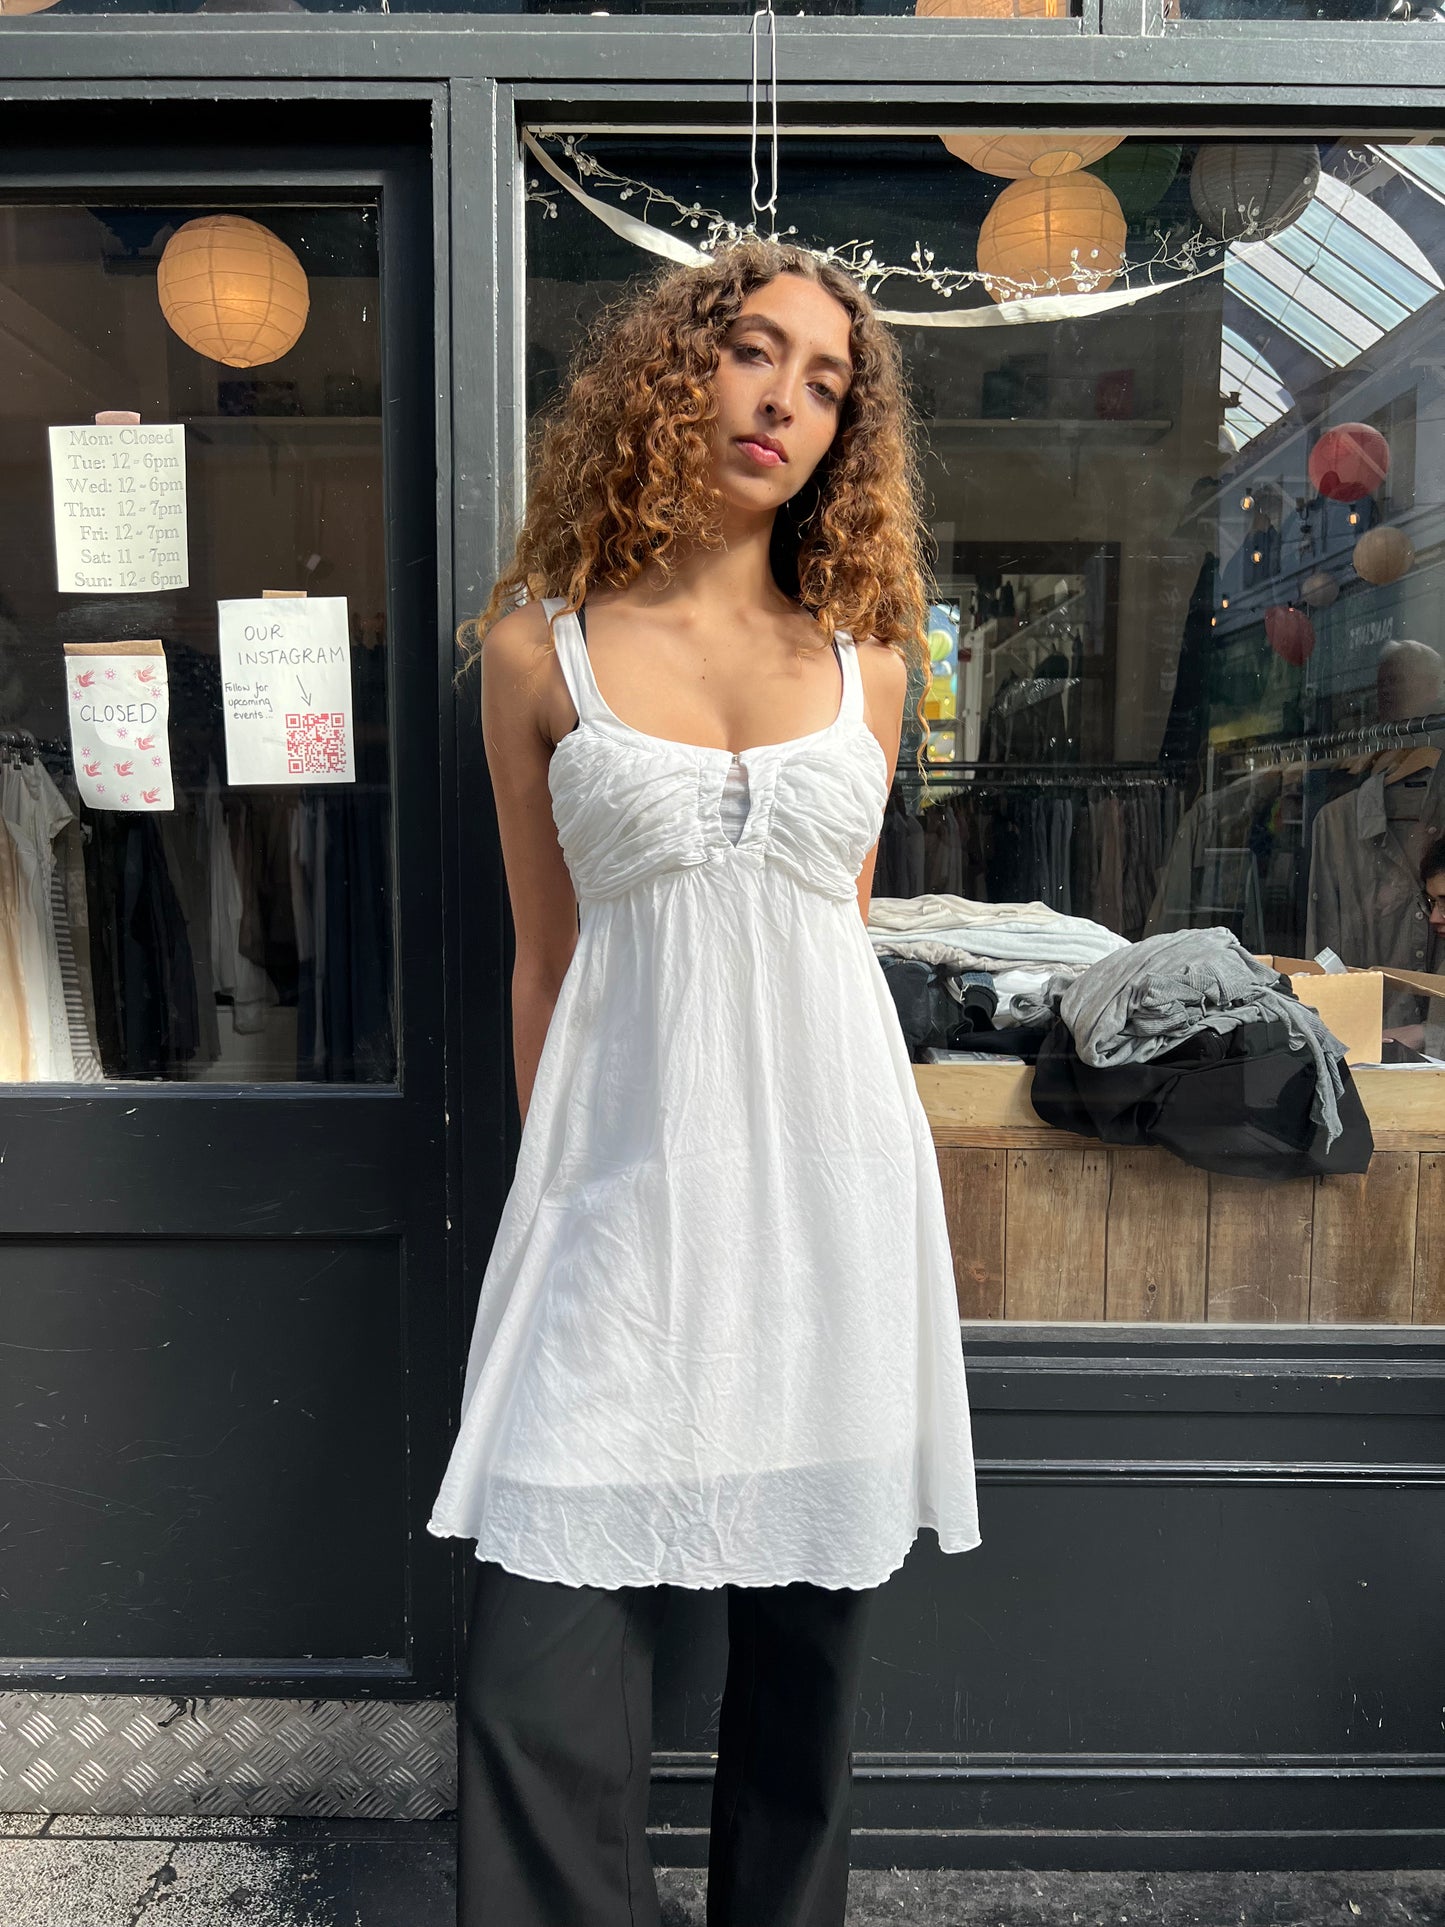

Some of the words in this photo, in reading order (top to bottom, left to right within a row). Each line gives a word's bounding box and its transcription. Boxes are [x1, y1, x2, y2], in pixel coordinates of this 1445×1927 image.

[69, 430, 113, 446] Mon:
[119, 428, 175, 445] Closed
[67, 454, 106, 469] Tue:
[65, 478, 112, 493] Wed:
[63, 502, 106, 517] Thu:
[79, 525, 109, 540] Fri:
[80, 549, 112, 564] Sat:
[74, 572, 112, 587] Sun:
[244, 624, 284, 641] OUR
[238, 646, 345, 666] INSTAGRAM
[224, 681, 250, 693] Follow
[253, 681, 269, 699] for
[228, 697, 273, 712] upcoming
[80, 702, 157, 724] CLOSED
